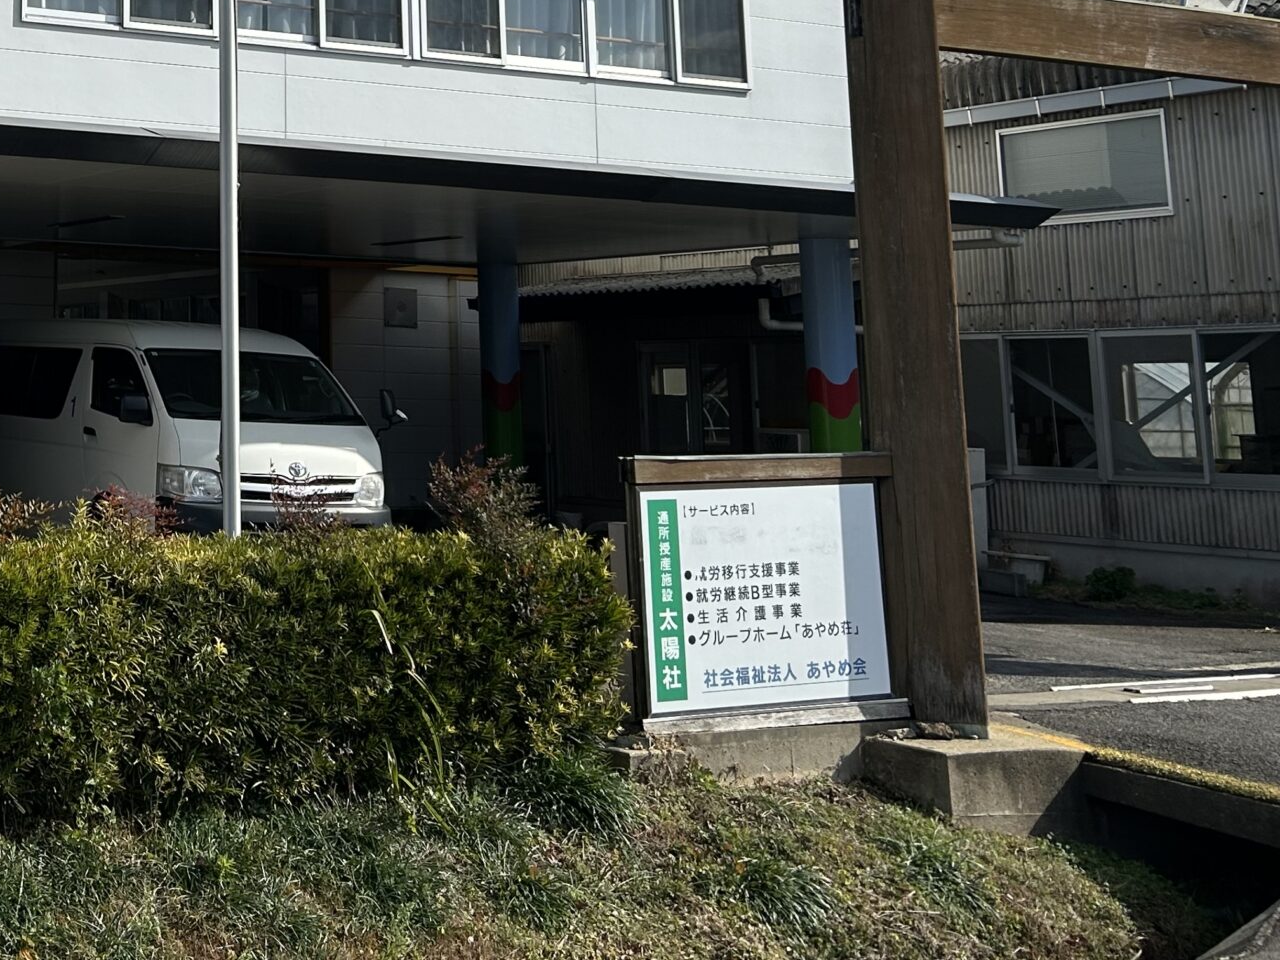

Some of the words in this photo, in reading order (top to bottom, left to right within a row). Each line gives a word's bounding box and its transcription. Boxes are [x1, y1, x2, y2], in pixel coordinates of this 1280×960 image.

[659, 608, 682, 690] 太陽社
[703, 662, 797, 688] 社会福祉法人
[806, 657, 867, 679] あやめ会
